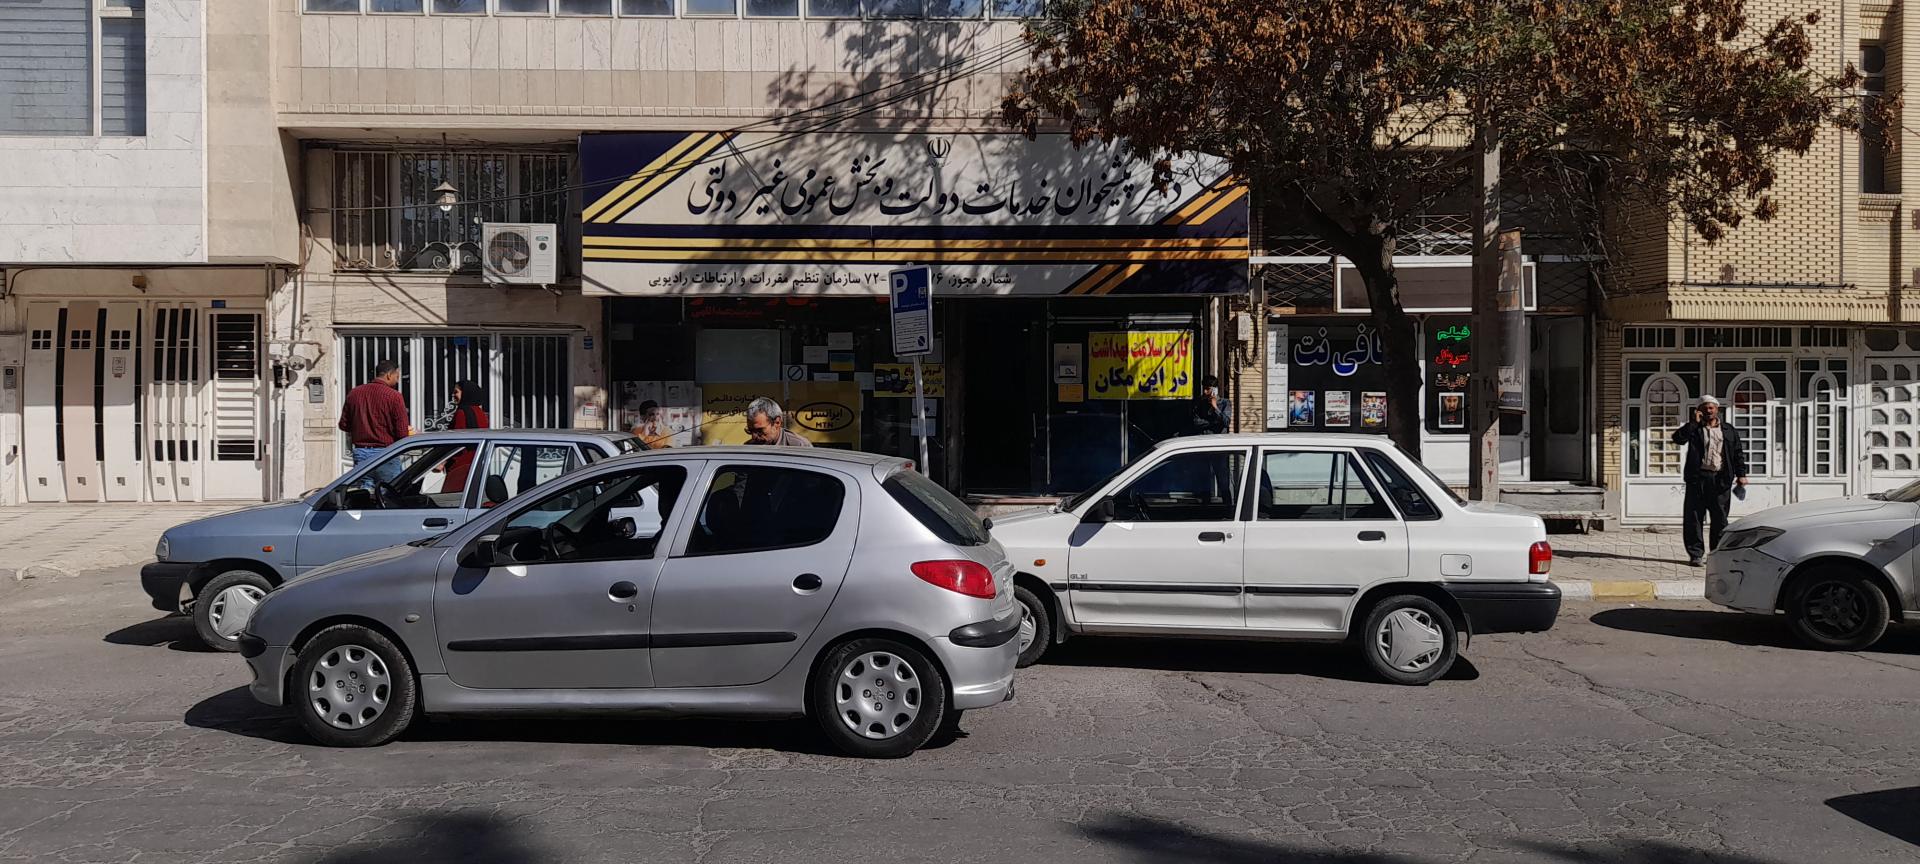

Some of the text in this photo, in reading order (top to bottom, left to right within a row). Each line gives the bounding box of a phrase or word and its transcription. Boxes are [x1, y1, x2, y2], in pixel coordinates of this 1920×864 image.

[687, 159, 737, 216] دولتی
[734, 159, 788, 220] غیر
[780, 169, 836, 216] عمومی
[829, 155, 887, 216] بخش
[880, 177, 894, 196] و
[880, 177, 960, 216] دولت
[962, 178, 1051, 216] خدمات
[1054, 155, 1134, 216] پیشخوان
[648, 271, 688, 287] رادیویی
[691, 271, 737, 287] ارتباطات
[740, 276, 747, 287] و
[749, 271, 788, 287] مقررات
[792, 271, 819, 290] تنظیم
[824, 271, 861, 287] سازمان
[981, 272, 1012, 288] شماره
[892, 273, 909, 309] P
[1437, 325, 1471, 342] فیلم
[1091, 334, 1190, 363] کارت سلامت بهداشت
[1294, 326, 1331, 367] نت
[1434, 347, 1471, 369] سریال
[1095, 366, 1134, 393] مکان
[1138, 366, 1164, 393] این
[1169, 370, 1188, 393] در
[805, 408, 843, 421] ایرانسل
[815, 421, 833, 429] MTN
